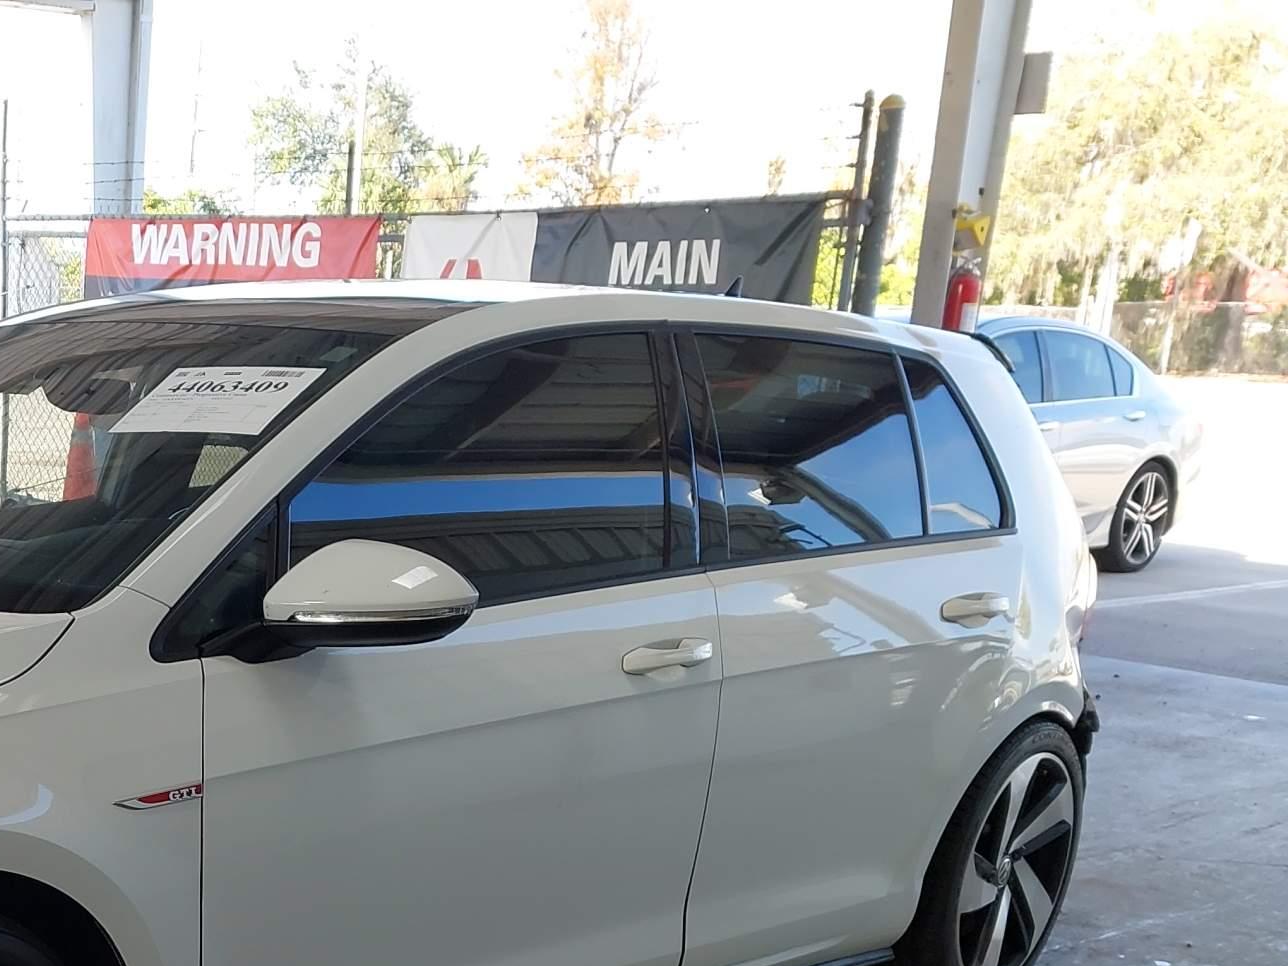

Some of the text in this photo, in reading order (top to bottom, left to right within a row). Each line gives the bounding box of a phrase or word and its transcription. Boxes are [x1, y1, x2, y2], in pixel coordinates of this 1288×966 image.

[131, 222, 322, 268] WARNING
[608, 239, 721, 285] MAIN
[167, 380, 289, 393] 44063409
[168, 786, 203, 801] GTI
